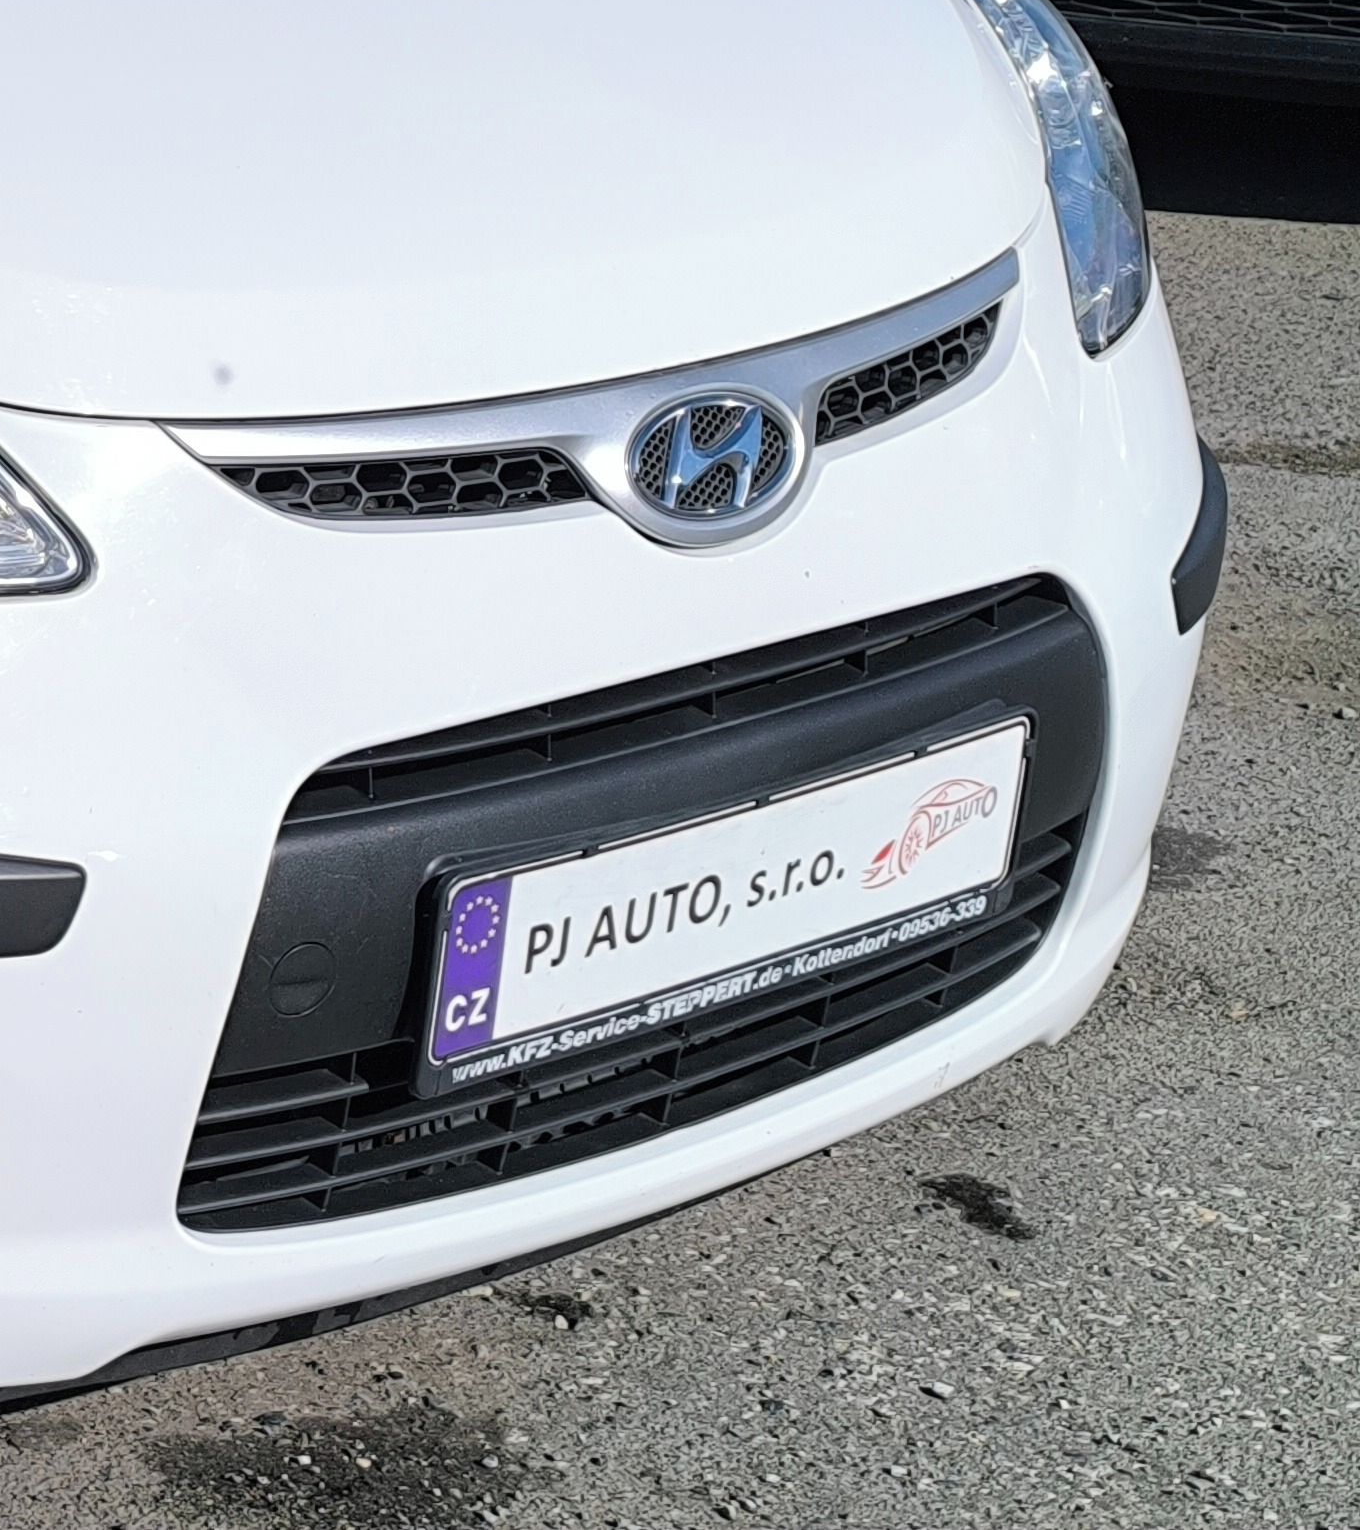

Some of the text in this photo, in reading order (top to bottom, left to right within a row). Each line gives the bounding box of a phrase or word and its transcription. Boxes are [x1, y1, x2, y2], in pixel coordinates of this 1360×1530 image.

[525, 850, 845, 974] PJ AUTO, s.r.o.
[444, 987, 491, 1032] CZ
